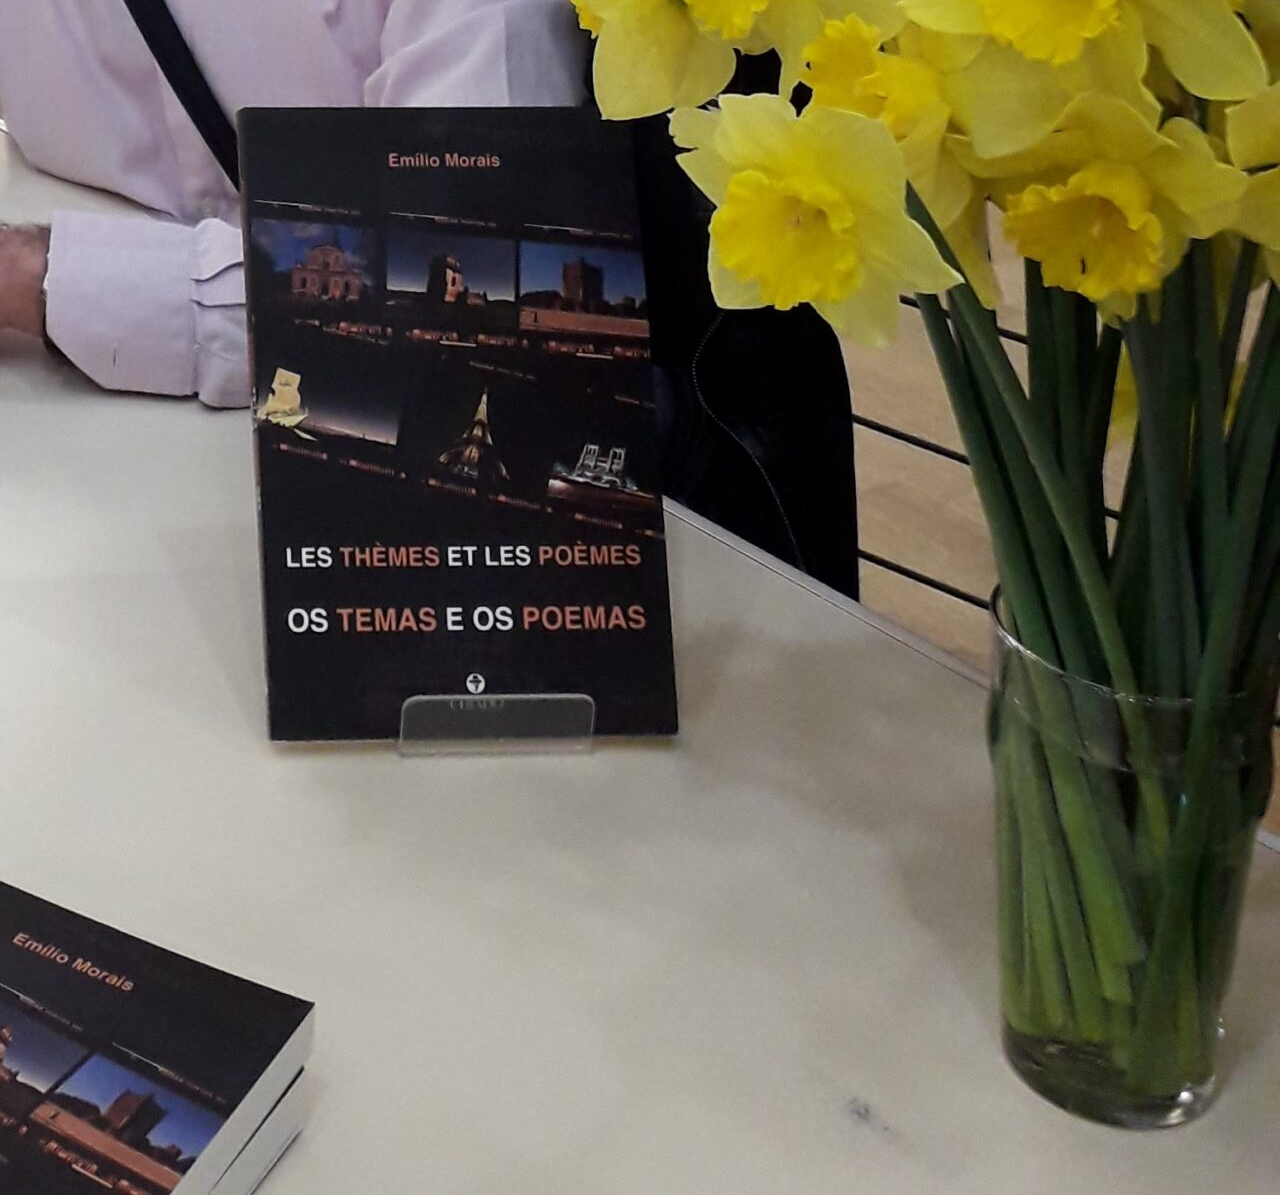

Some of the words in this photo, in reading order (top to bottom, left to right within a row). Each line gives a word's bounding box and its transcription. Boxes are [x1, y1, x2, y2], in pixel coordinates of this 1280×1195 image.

[388, 152, 440, 167] Emílio
[444, 152, 500, 167] Morais
[286, 547, 333, 568] LES
[339, 541, 440, 567] THÈMES
[447, 546, 478, 566] ET
[485, 545, 531, 566] LES
[538, 540, 642, 566] POÈMES
[287, 608, 329, 633] OS
[336, 607, 437, 632] TEMAS
[446, 607, 464, 631] E
[473, 606, 514, 631] OS
[522, 605, 646, 630] POEMAS
[12, 933, 69, 963] Emílio
[72, 957, 134, 991] Morais
